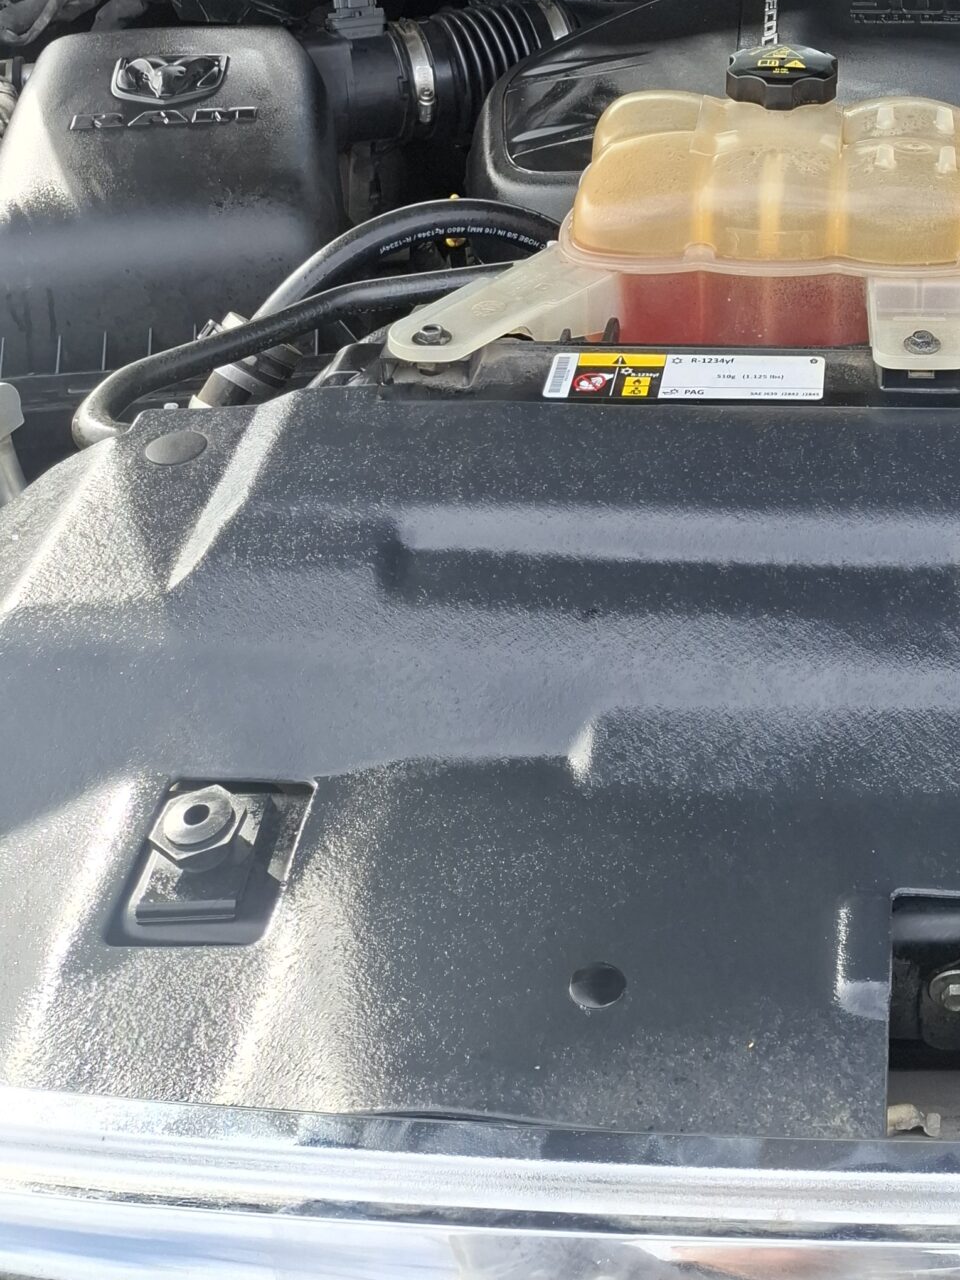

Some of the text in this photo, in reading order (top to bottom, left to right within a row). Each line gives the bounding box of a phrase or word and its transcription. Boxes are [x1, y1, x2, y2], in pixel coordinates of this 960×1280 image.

[69, 106, 258, 130] RAM
[518, 234, 540, 247] HOSE
[691, 357, 735, 365] R-1234yf
